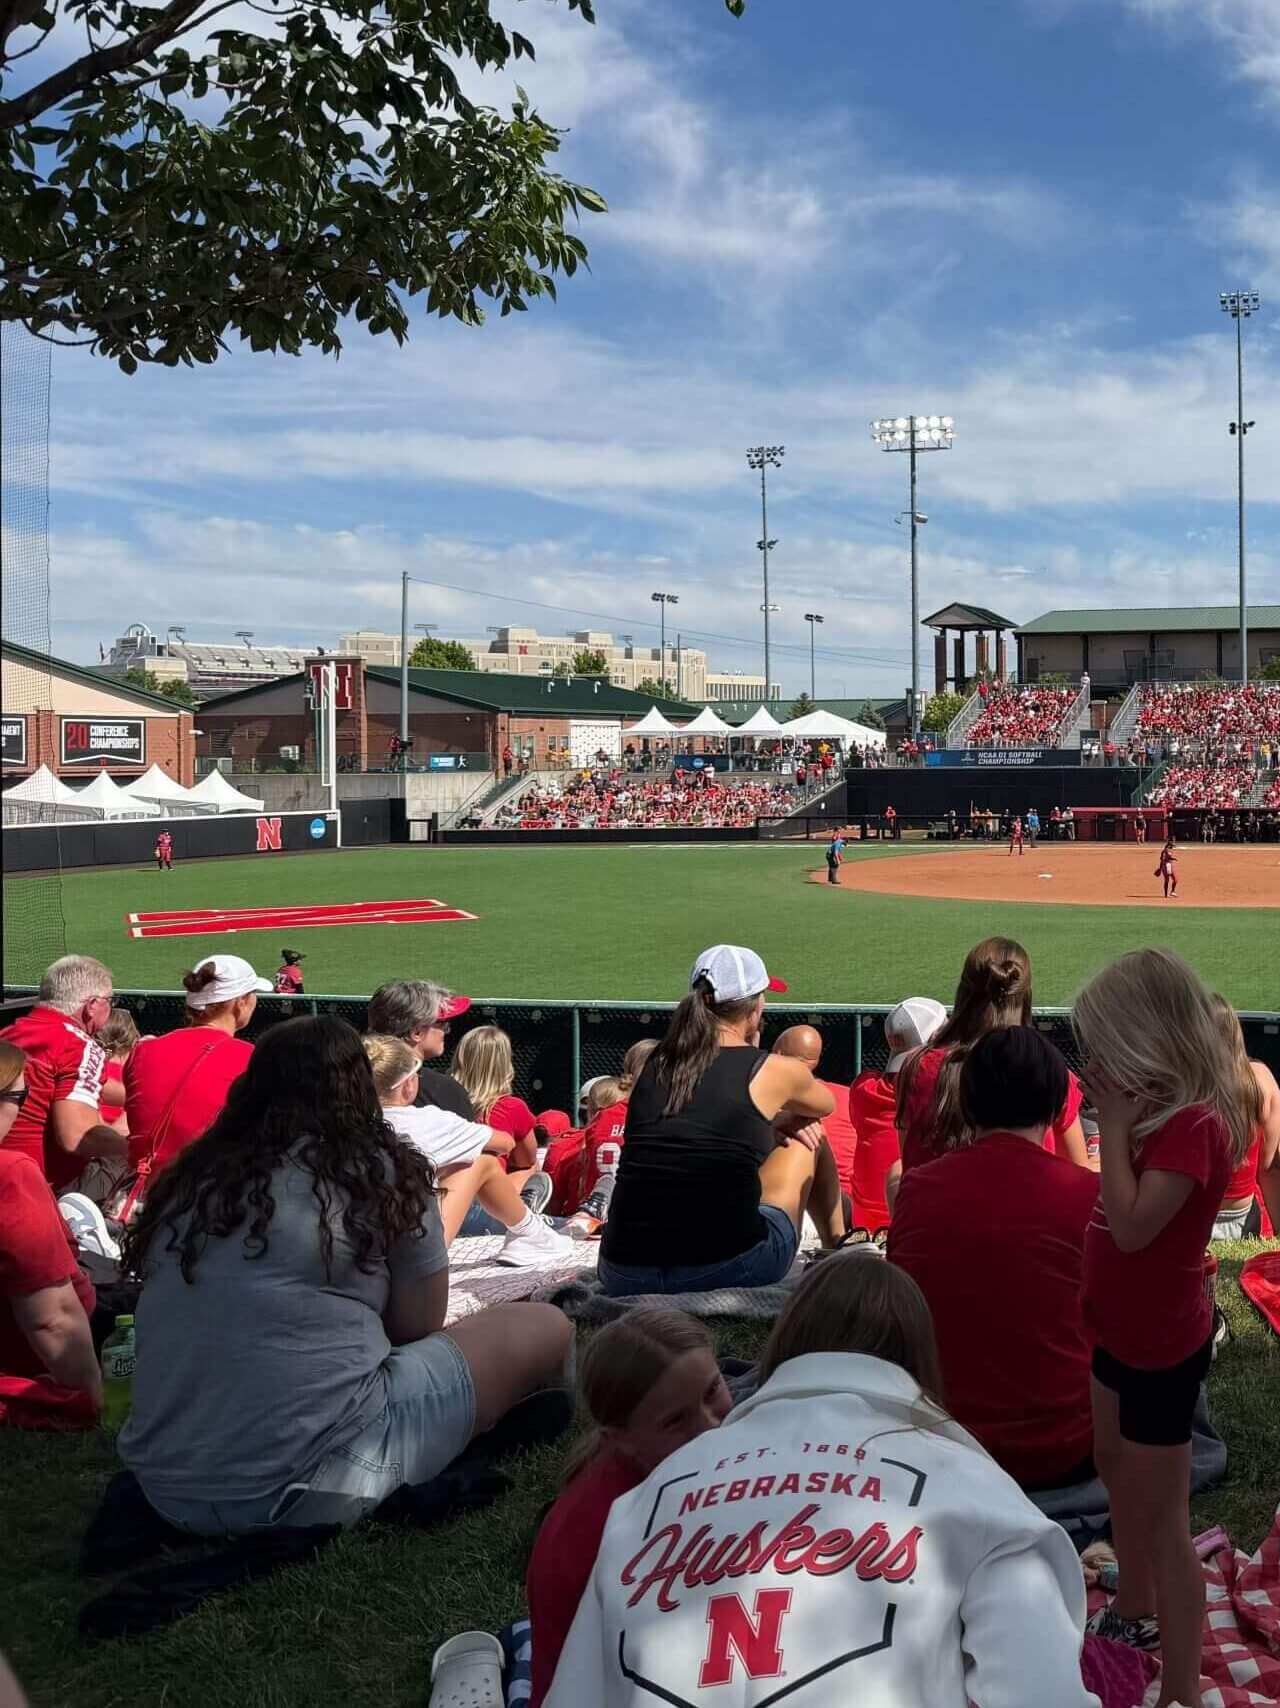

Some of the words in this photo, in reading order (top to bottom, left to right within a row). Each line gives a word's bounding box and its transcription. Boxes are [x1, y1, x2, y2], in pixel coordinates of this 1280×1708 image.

[66, 724, 89, 749] 20
[256, 817, 282, 851] N
[714, 1448, 776, 1471] EST.
[803, 1443, 867, 1461] 1869
[678, 1472, 882, 1516] NEBRASKA
[620, 1504, 923, 1612] Huskers
[698, 1587, 793, 1688] N
